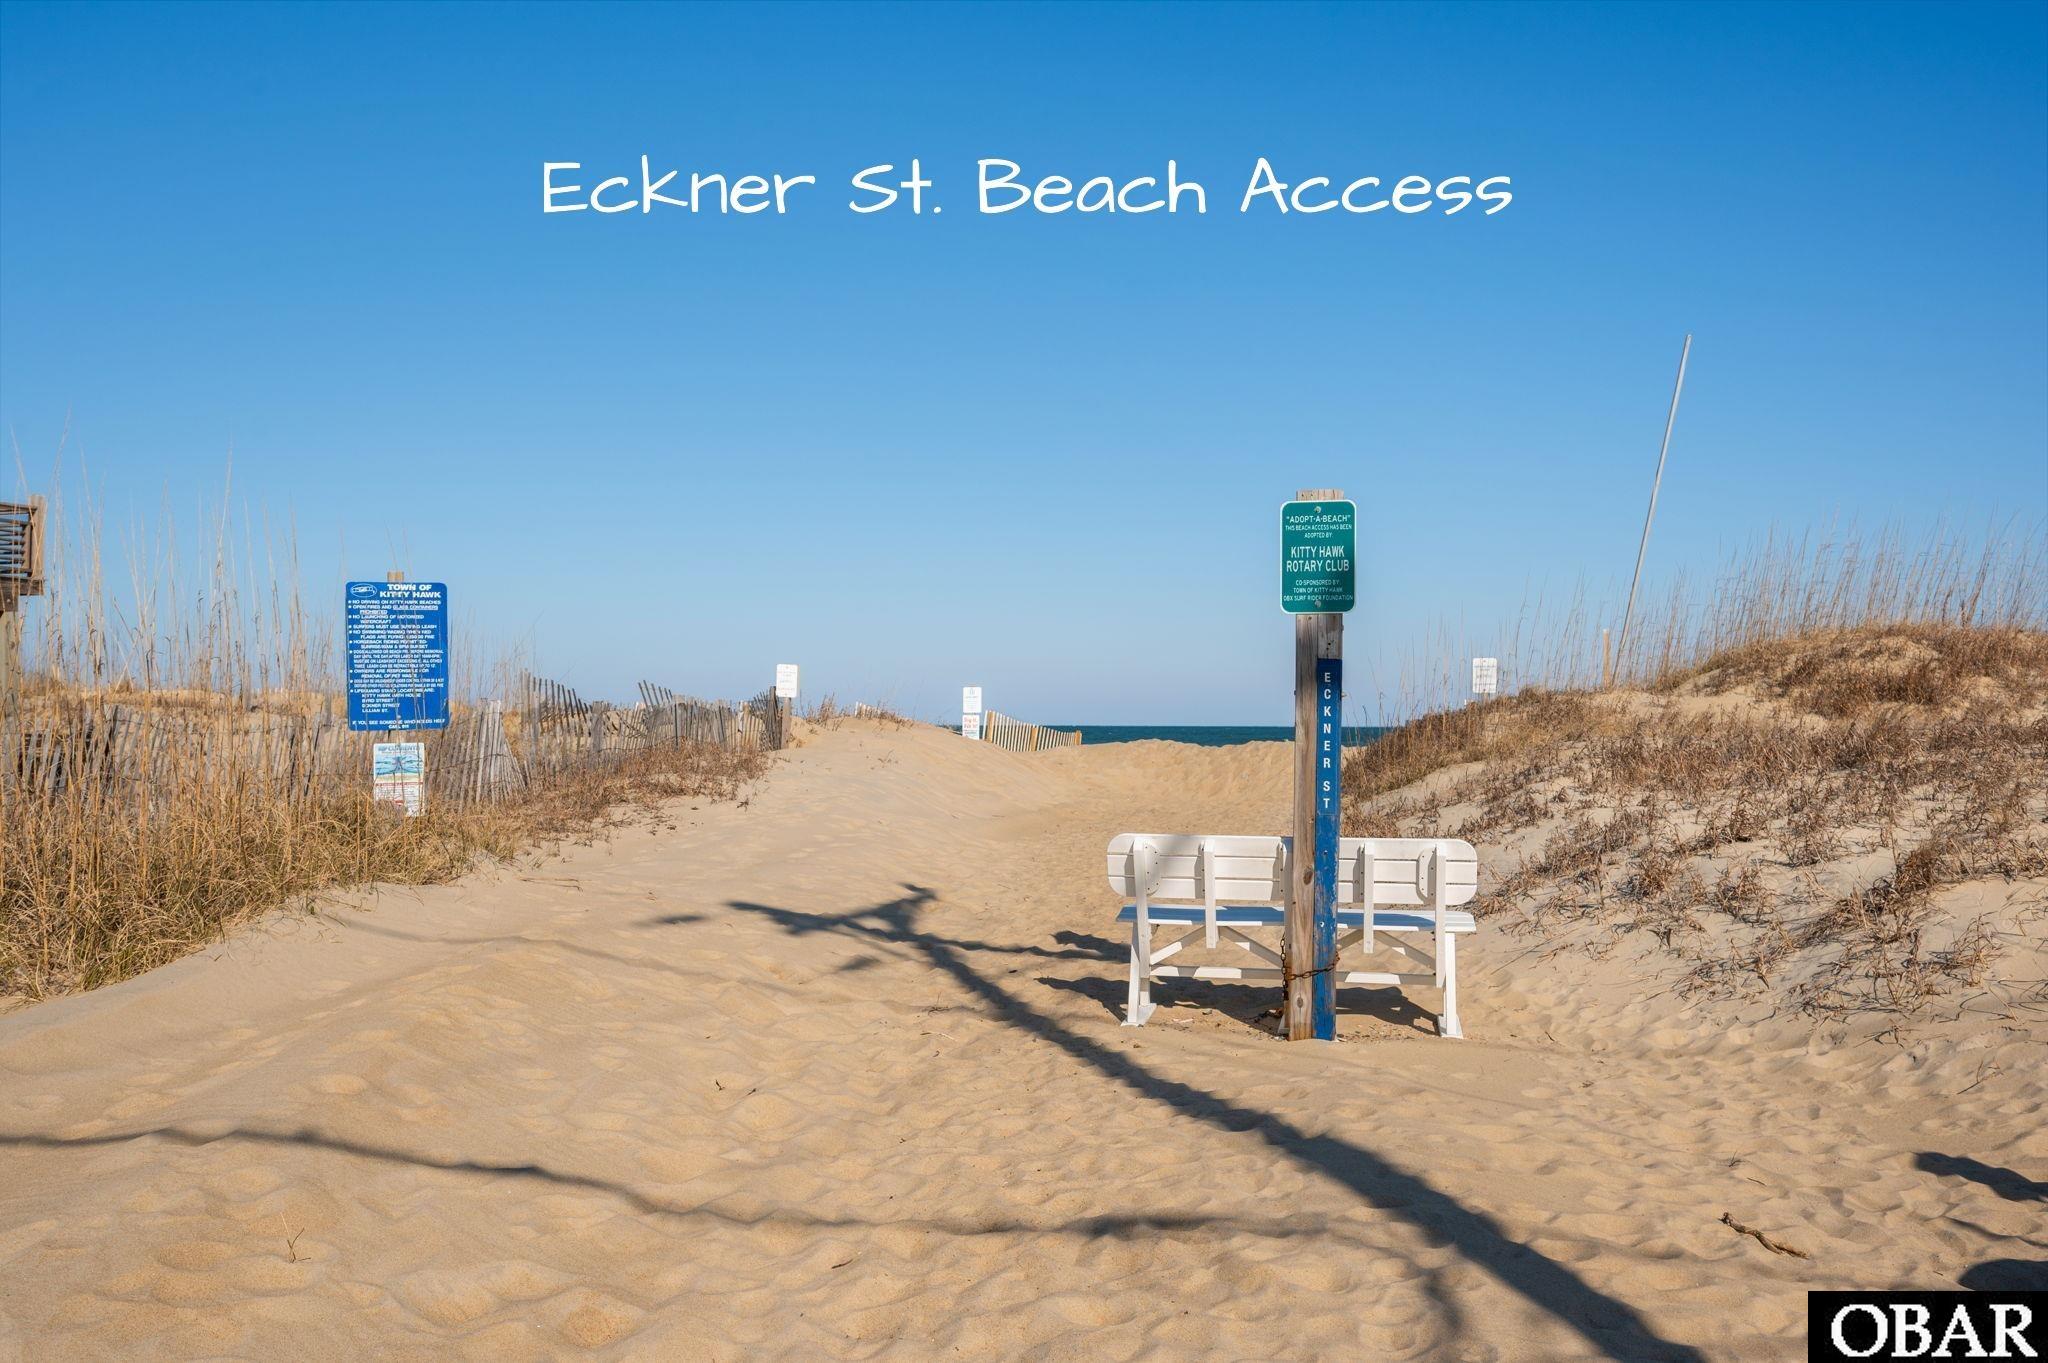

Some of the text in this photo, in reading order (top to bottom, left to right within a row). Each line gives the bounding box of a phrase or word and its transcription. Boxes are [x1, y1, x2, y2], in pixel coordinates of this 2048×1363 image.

[1291, 546, 1345, 558] KITTY HAWK
[1286, 560, 1350, 572] ROTARY CLUB
[1323, 672, 1332, 808] ECKNER ST
